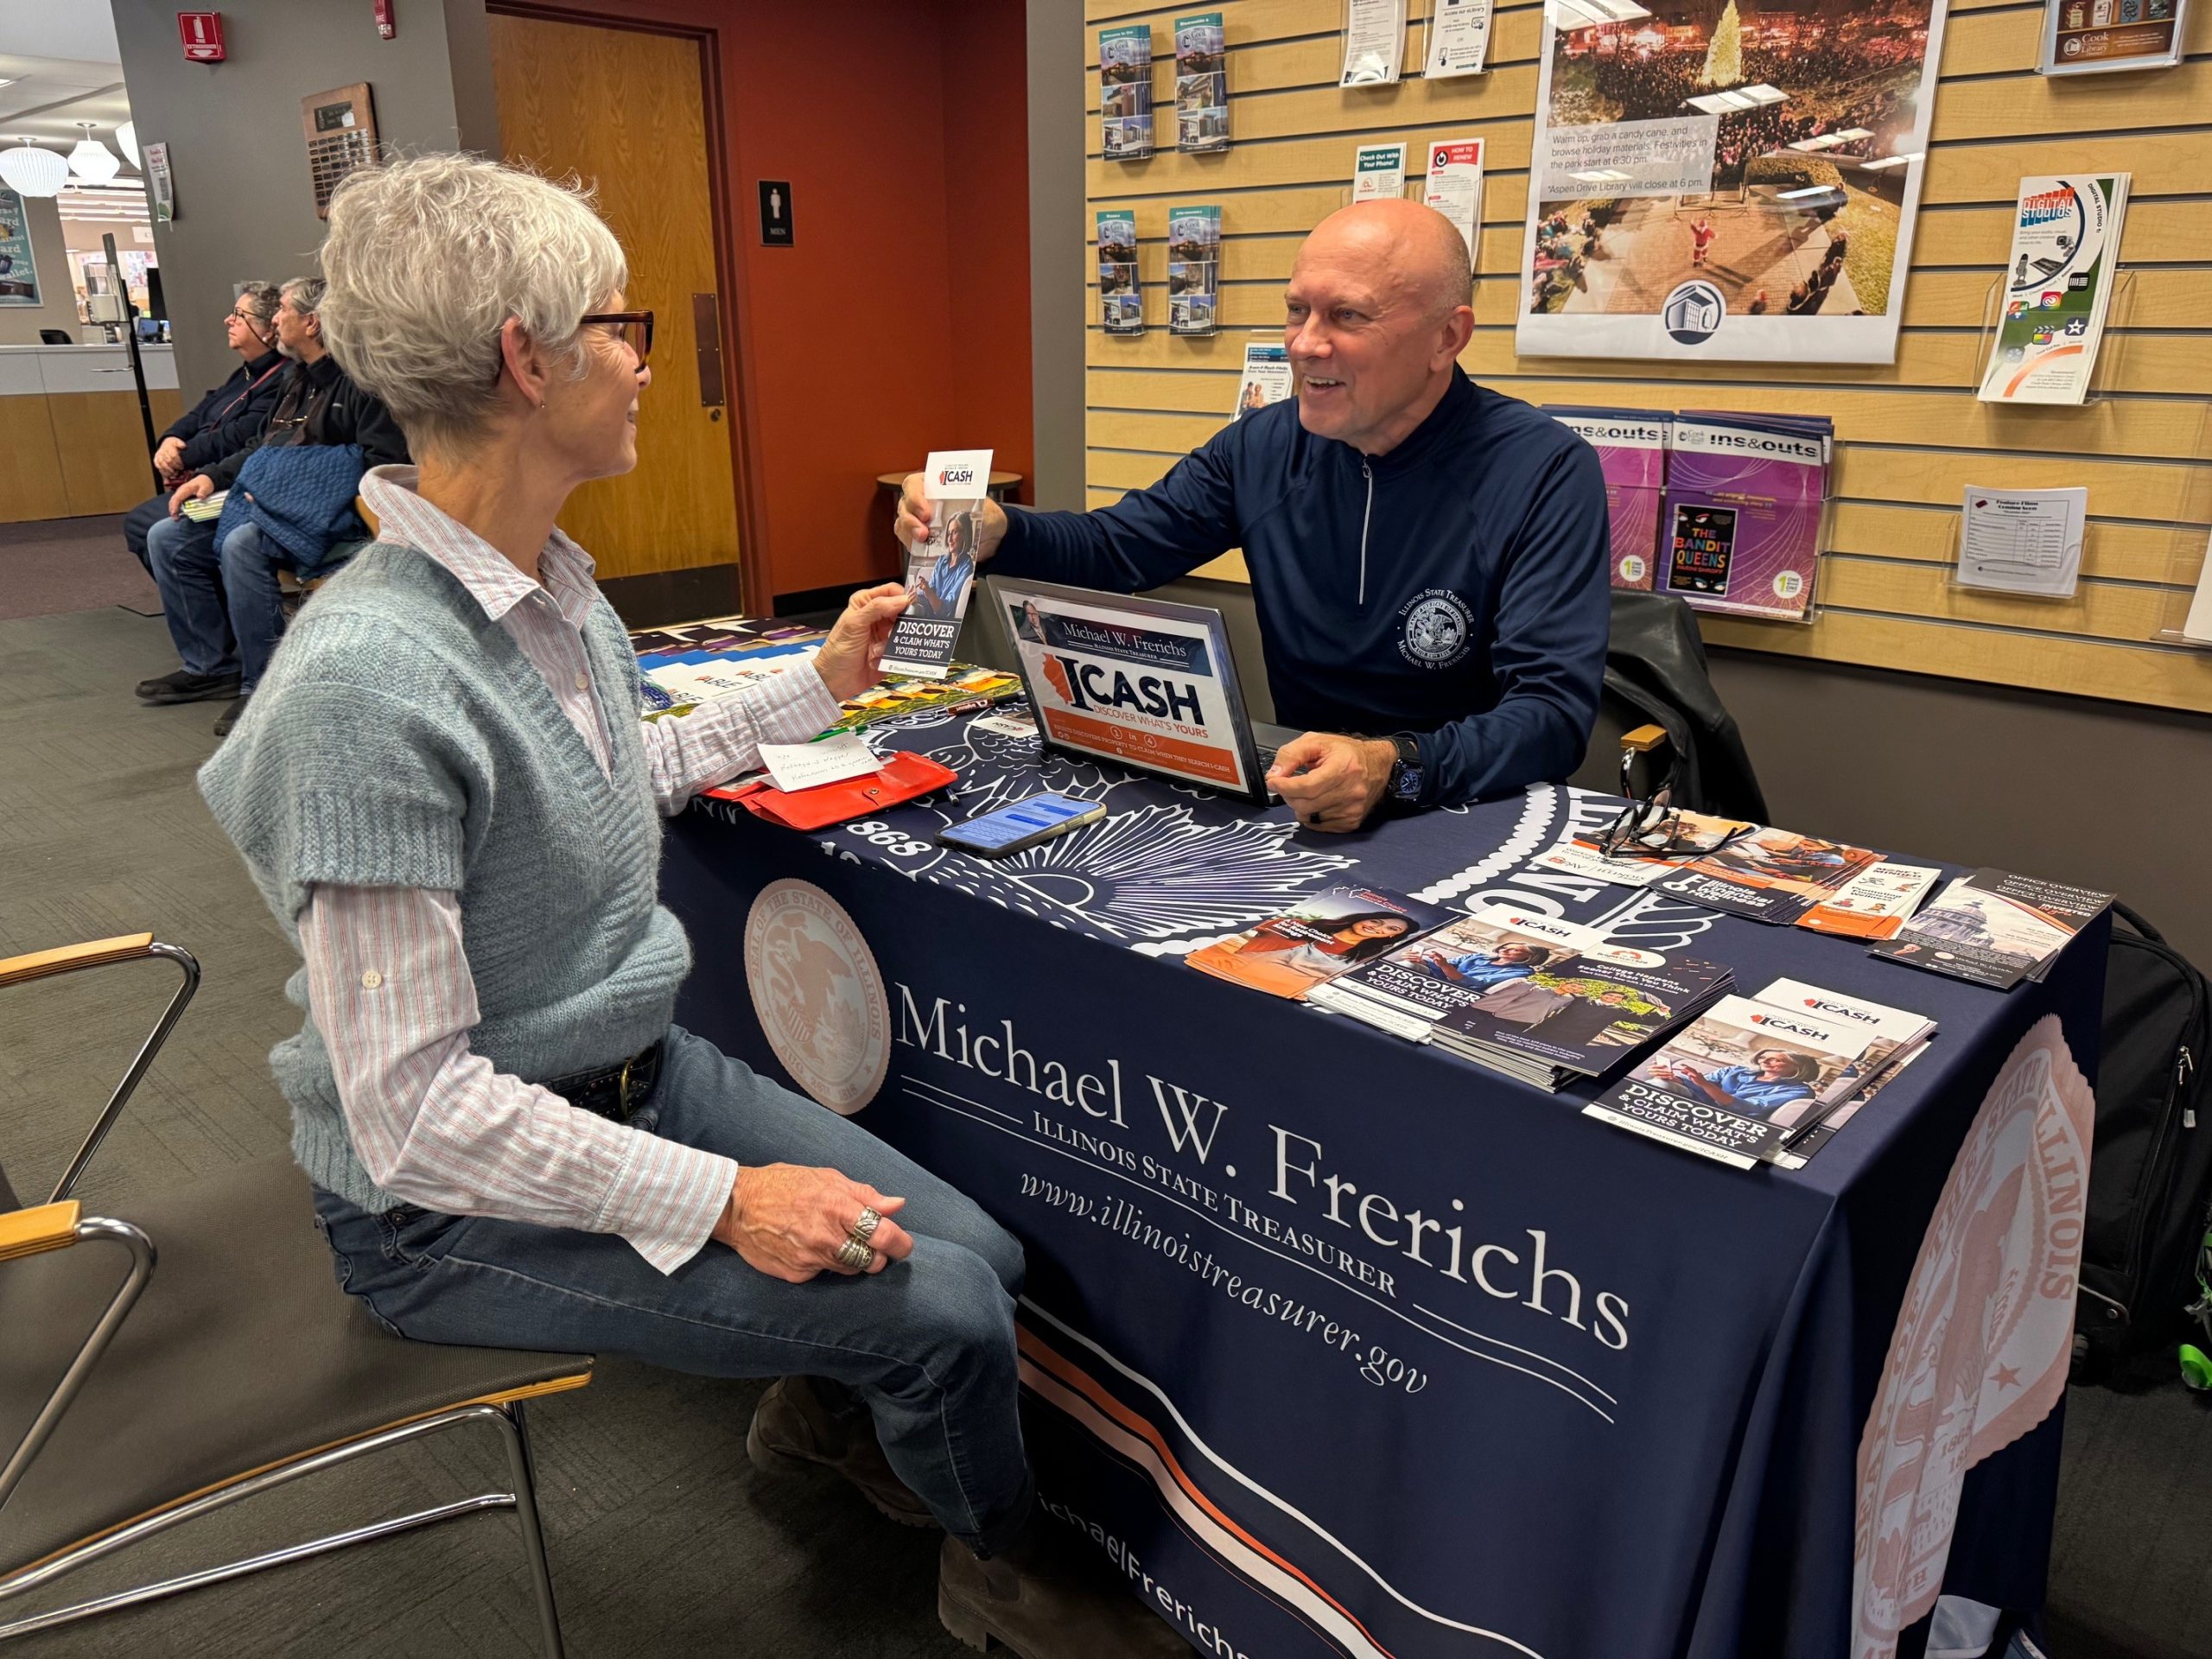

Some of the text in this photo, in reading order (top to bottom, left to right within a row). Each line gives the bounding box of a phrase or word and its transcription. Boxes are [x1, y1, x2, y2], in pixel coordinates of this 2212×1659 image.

[2082, 32, 2110, 44] Cook
[2082, 43, 2108, 54] Library
[1553, 135, 1575, 143] Warm
[1592, 132, 1610, 143] grab
[1618, 130, 1643, 141] candy
[1671, 126, 1688, 137] and
[1359, 154, 1376, 162] Check
[1551, 148, 1580, 157] browse
[1582, 144, 1611, 156] holiday
[1654, 140, 1697, 149] Festivities
[1699, 138, 1707, 147] in
[1550, 161, 1562, 169] the
[1564, 159, 1582, 170] park
[1584, 157, 1601, 167] start
[1603, 157, 1611, 166] at
[1612, 156, 1631, 165] 6:30
[1577, 182, 1598, 193] Drive
[1599, 181, 1626, 194] Library
[1629, 181, 1643, 190] will
[1644, 180, 1668, 189] close
[1669, 179, 1678, 188] at
[1680, 179, 1686, 188] 6
[2088, 183, 2101, 205] DIGITAL
[2022, 195, 2074, 210] DIGITAL
[2021, 207, 2073, 221] STUDIOS
[1569, 425, 1661, 442] ns&outs
[1710, 432, 1819, 458] ins&outs
[942, 469, 973, 485] ICASH
[1692, 528, 1717, 538] THE
[1674, 537, 1732, 554] BANDIT
[1676, 550, 1727, 569] QUEENS
[1398, 588, 1474, 624] ILLINOIS STATE TREASURER
[896, 621, 956, 639] DISCOVER
[1061, 621, 1188, 657] Michael W. Frerichs
[894, 645, 944, 660] YOURS TODAY
[899, 636, 923, 647] CLAIM
[923, 638, 950, 649] WHAT'S
[1128, 649, 1158, 660] TREASURER
[1397, 639, 1471, 670] MICHAEL W. FRERICHS
[1056, 656, 1206, 725] ICASH
[1092, 704, 1210, 739] DISCOVER WHAT'S YOURS
[1128, 733, 1138, 741] in
[846, 821, 933, 856] 868
[1872, 869, 1923, 878] MINDED
[1687, 888, 1719, 902] Hub
[1696, 885, 1767, 908] Wellness
[1703, 882, 1775, 905] Financial
[1707, 878, 1757, 896] Illinois
[1852, 885, 1902, 899] Promoting
[1852, 889, 1897, 901] Financial
[2003, 879, 2044, 893] OFFICE
[2044, 887, 2106, 905] OVERVIEW
[2007, 874, 2110, 899] OFFICE OVERVIEW
[1850, 892, 1893, 903] Wellness
[1996, 883, 2038, 899] OFFICE
[2038, 893, 2100, 912] OVERVIEW
[1291, 920, 1333, 940] New Choice
[1291, 925, 1336, 944] Retirement
[1514, 918, 1573, 938] ICASH
[766, 891, 791, 913] THE
[792, 891, 832, 919] STATE
[834, 918, 854, 942] OF
[852, 946, 883, 1041] ILLINOIS
[1596, 963, 1680, 987] College Happens
[1374, 963, 1481, 1004] DISCOVER
[1577, 963, 1691, 994] Sooner Than You Think
[1365, 977, 1454, 1009] YOURS TODAY
[1377, 974, 1420, 991] CLAIM
[1420, 987, 1469, 1007] WHAT'S
[1812, 999, 1880, 1025] ICASH
[1758, 1015, 1829, 1042] ICASH
[1618, 1093, 1759, 1144] & CLAIM WHAT'S
[1624, 1084, 1769, 1137] DISCOVER
[1621, 1102, 1743, 1148] YOURS TODAY
[893, 982, 1630, 1351] Michael W. Frerichs
[1032, 1109, 1398, 1299] ILLINOIS STATE TREASURER
[1019, 1167, 1428, 1396] www.illinoistreasurer.gov
[1036, 1491, 1251, 1659] ichaelFrerich
